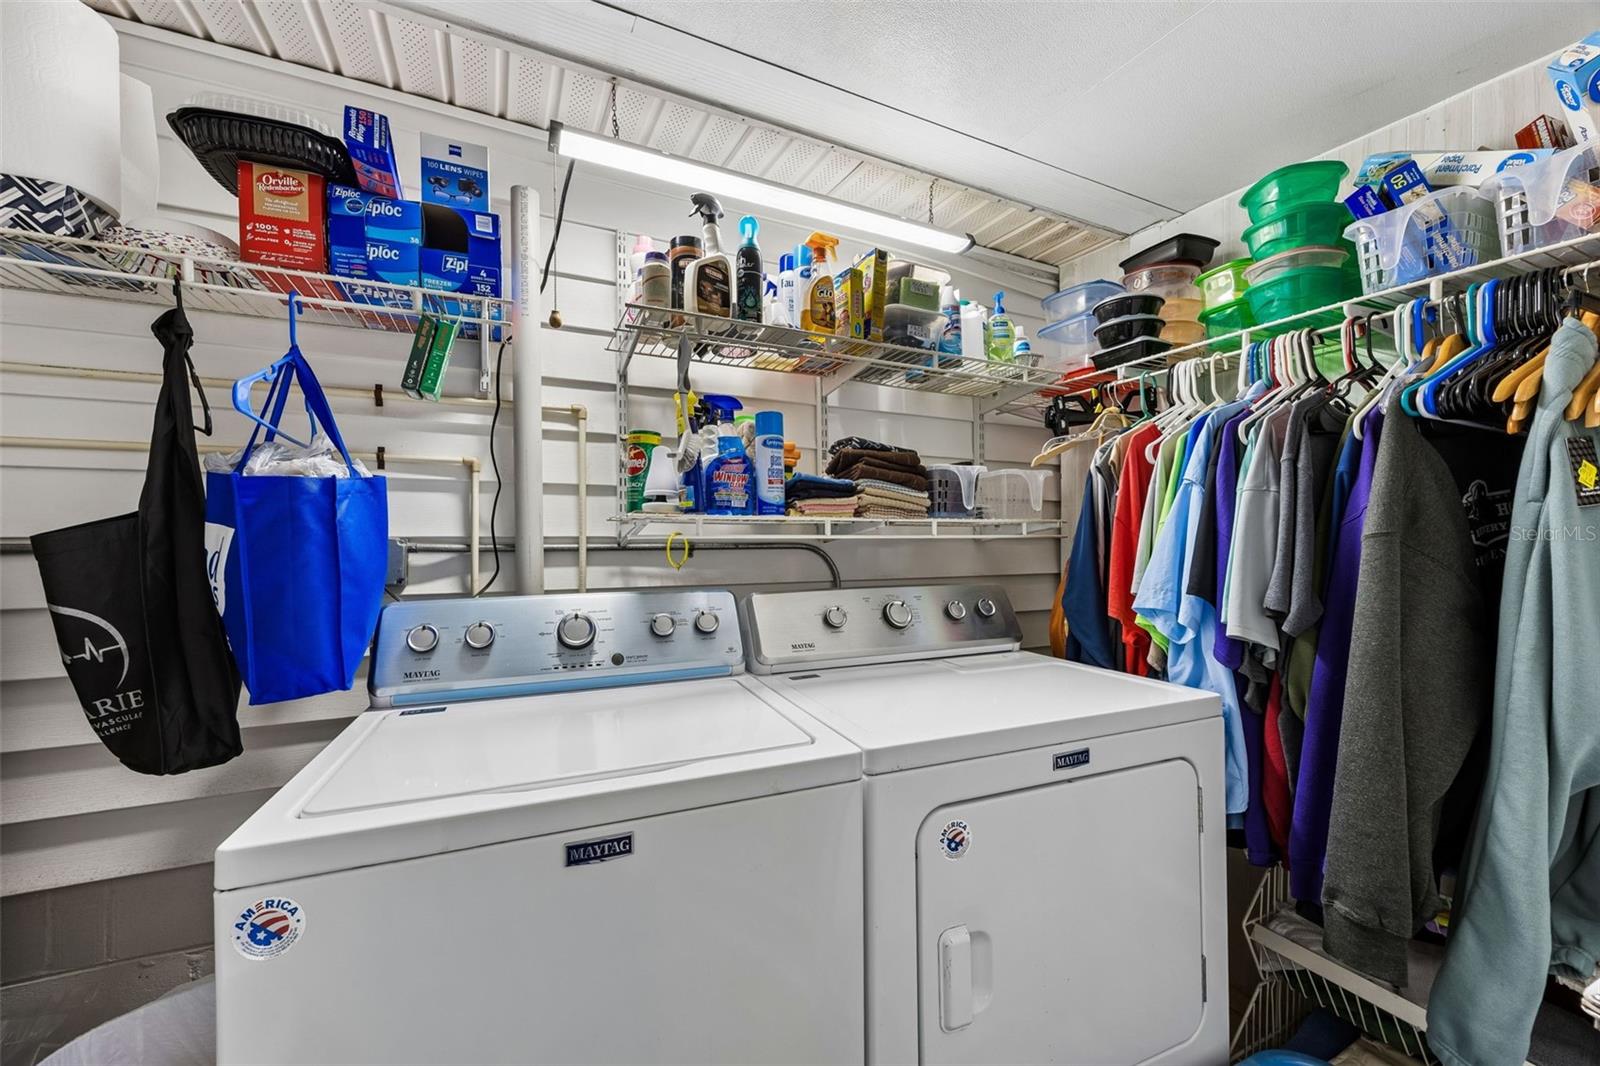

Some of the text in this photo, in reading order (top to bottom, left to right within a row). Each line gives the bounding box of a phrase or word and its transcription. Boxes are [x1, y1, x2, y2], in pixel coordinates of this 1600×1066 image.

[348, 108, 357, 139] Reynolds
[357, 110, 367, 143] Wrap 150
[1441, 155, 1465, 163] Paper
[427, 161, 484, 179] 100 LENS WIPES
[1435, 164, 1482, 174] Parchment
[262, 174, 298, 186] Orville
[1390, 174, 1407, 190] 50
[335, 187, 360, 198] Ziploc
[255, 222, 279, 231] 100%
[367, 243, 400, 260] iploc
[445, 257, 469, 273] Zipl
[352, 285, 409, 300] Ziplo
[476, 284, 491, 292] 152
[817, 289, 833, 298] GLO
[713, 470, 749, 485] WINDOW
[791, 642, 815, 650] MAYTAG
[403, 669, 441, 679] MAYTAG
[1057, 752, 1088, 767] MAYTAG
[569, 839, 630, 862] MAYTAG
[235, 899, 299, 931] AMERICA
